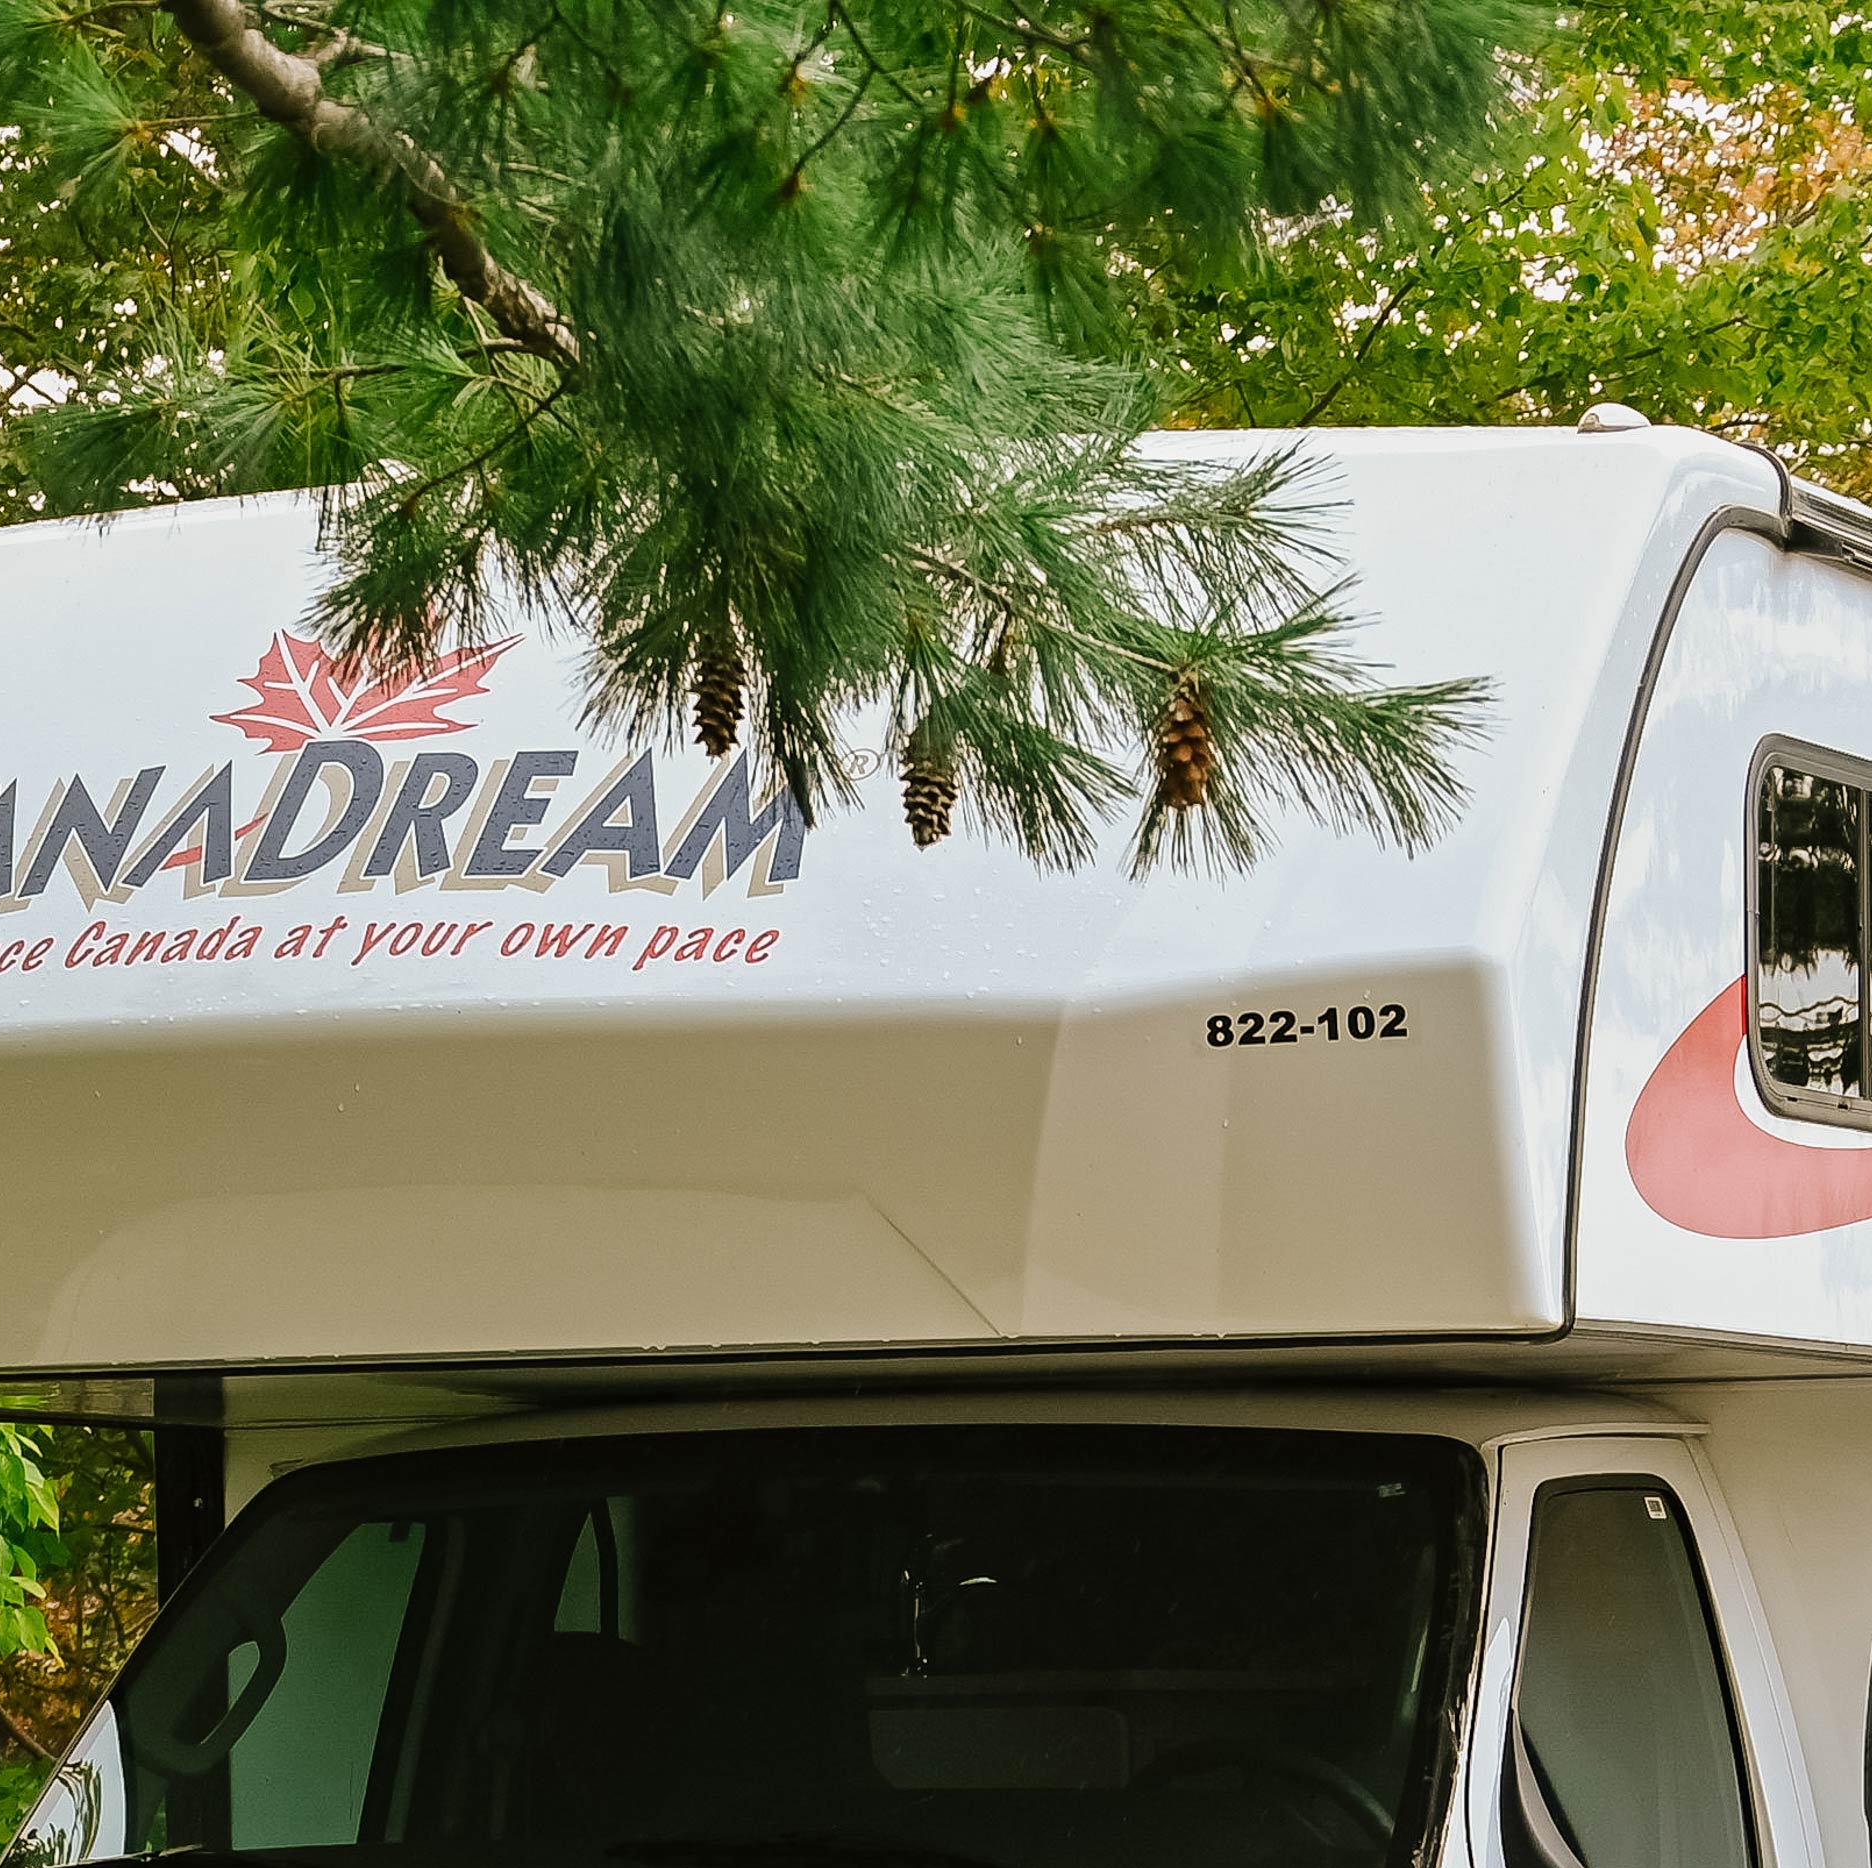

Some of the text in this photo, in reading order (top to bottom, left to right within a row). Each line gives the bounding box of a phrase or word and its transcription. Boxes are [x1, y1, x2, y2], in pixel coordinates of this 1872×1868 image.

[65, 916, 263, 969] Canada
[274, 915, 347, 959] at
[351, 921, 493, 966] your
[500, 922, 628, 959] own
[632, 924, 780, 971] pace
[1206, 1003, 1408, 1047] 822-102
